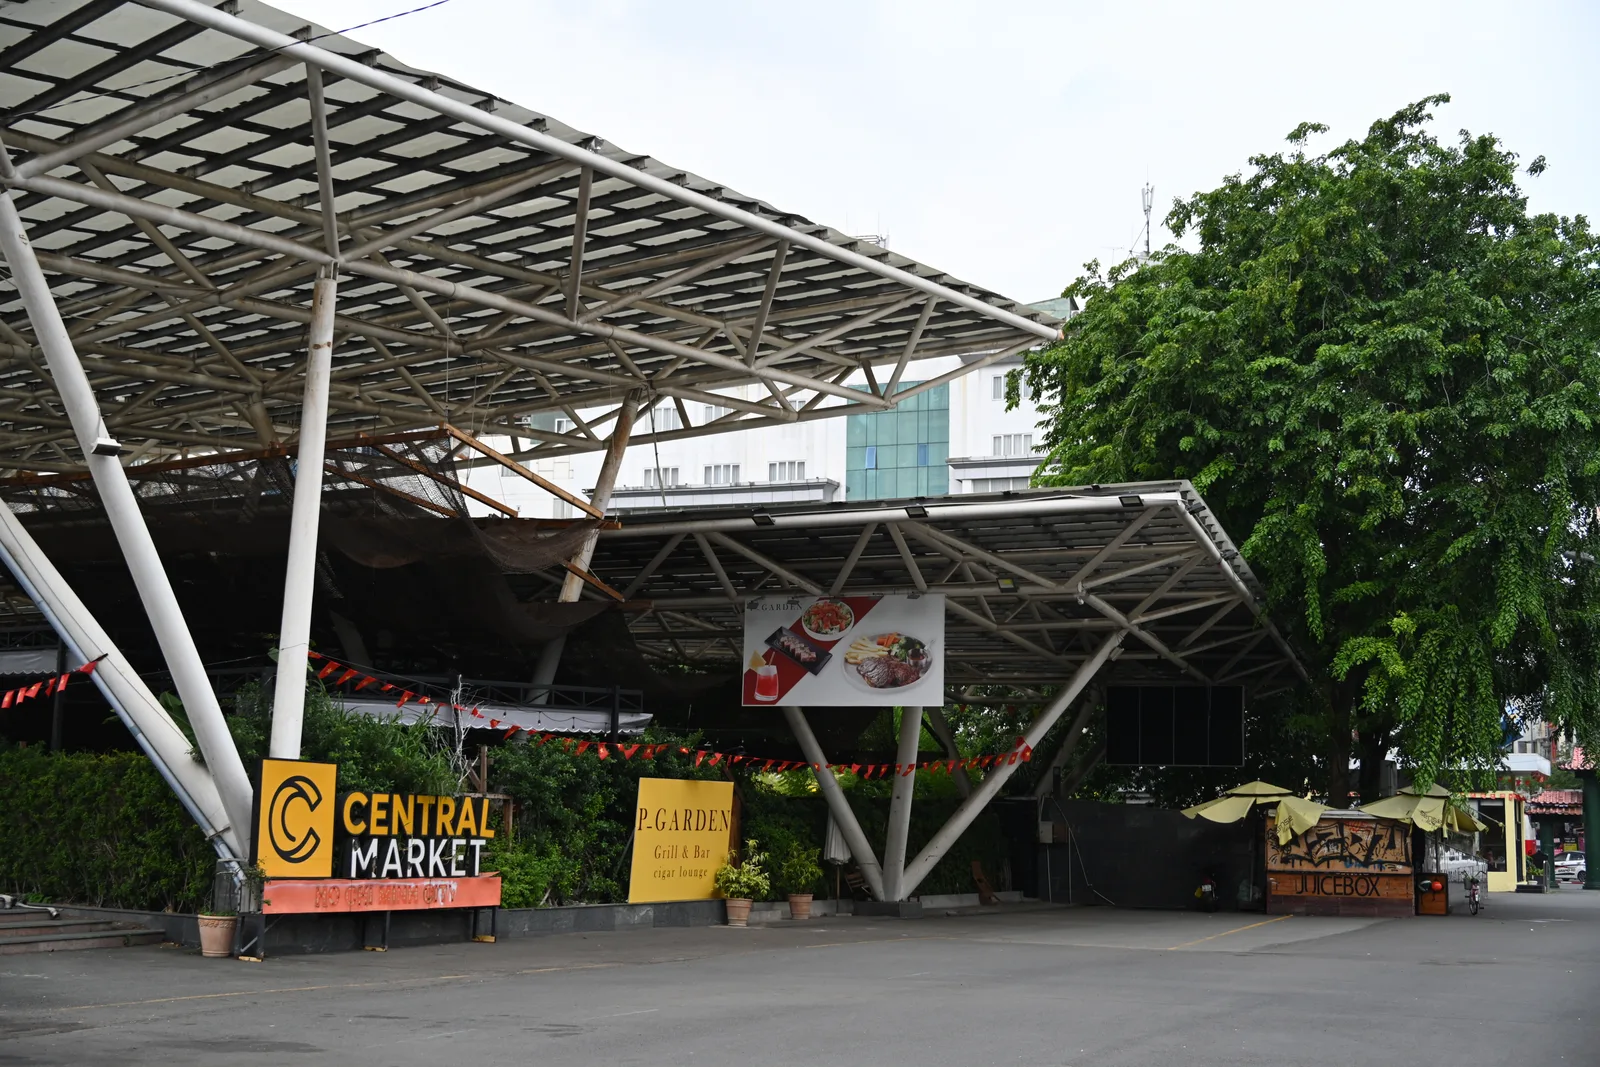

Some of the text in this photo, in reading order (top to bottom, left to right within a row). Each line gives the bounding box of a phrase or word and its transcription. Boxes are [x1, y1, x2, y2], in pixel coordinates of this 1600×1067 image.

[342, 791, 496, 838] CENTRAL
[350, 838, 487, 878] MARKET
[654, 845, 710, 859] Grill & Bar
[653, 865, 707, 880] cigar lounge
[1296, 875, 1381, 897] JUICEBOX
